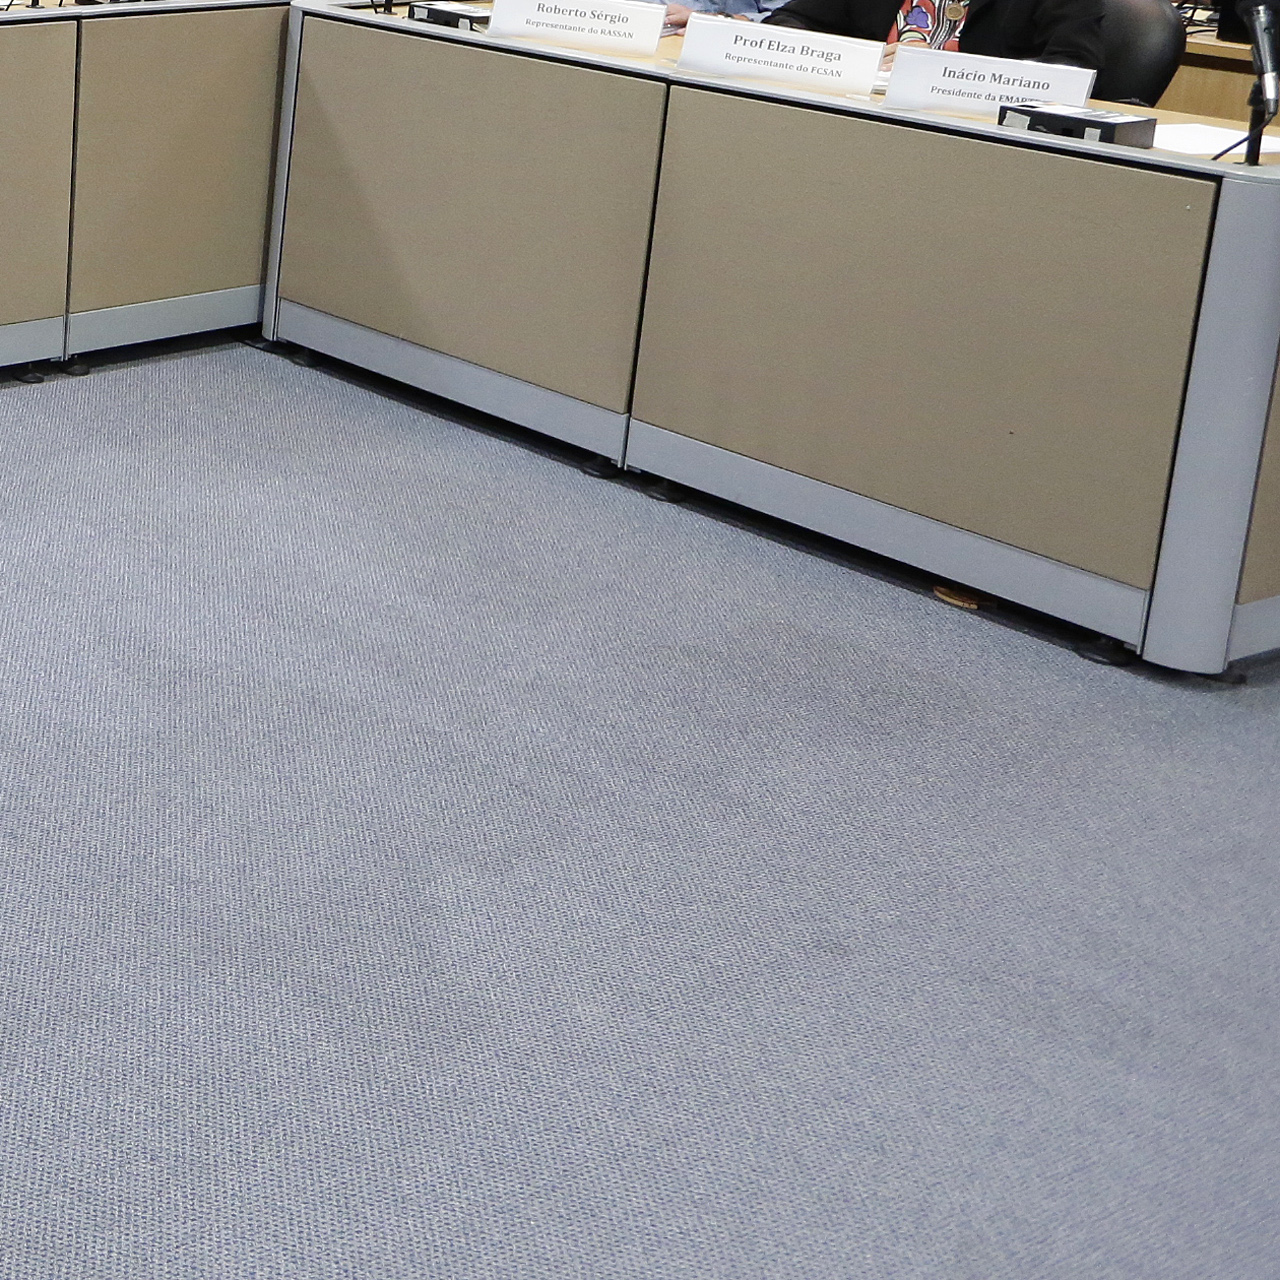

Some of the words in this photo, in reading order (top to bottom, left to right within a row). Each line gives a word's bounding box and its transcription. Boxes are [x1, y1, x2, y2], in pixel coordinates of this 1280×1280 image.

[536, 2, 587, 18] Roberto
[589, 10, 630, 24] Sérgio
[525, 18, 586, 33] Representante
[588, 27, 599, 35] do
[600, 28, 634, 39] RASSAN
[733, 34, 766, 49] Prof
[767, 39, 796, 54] Elza
[800, 45, 842, 63] Braga
[724, 52, 794, 70] Representante
[796, 64, 809, 73] do
[811, 66, 843, 78] FCSAN
[942, 66, 986, 83] Inácio
[989, 73, 1050, 91] Mariano
[930, 85, 983, 101] Presidente
[985, 93, 996, 101] da
